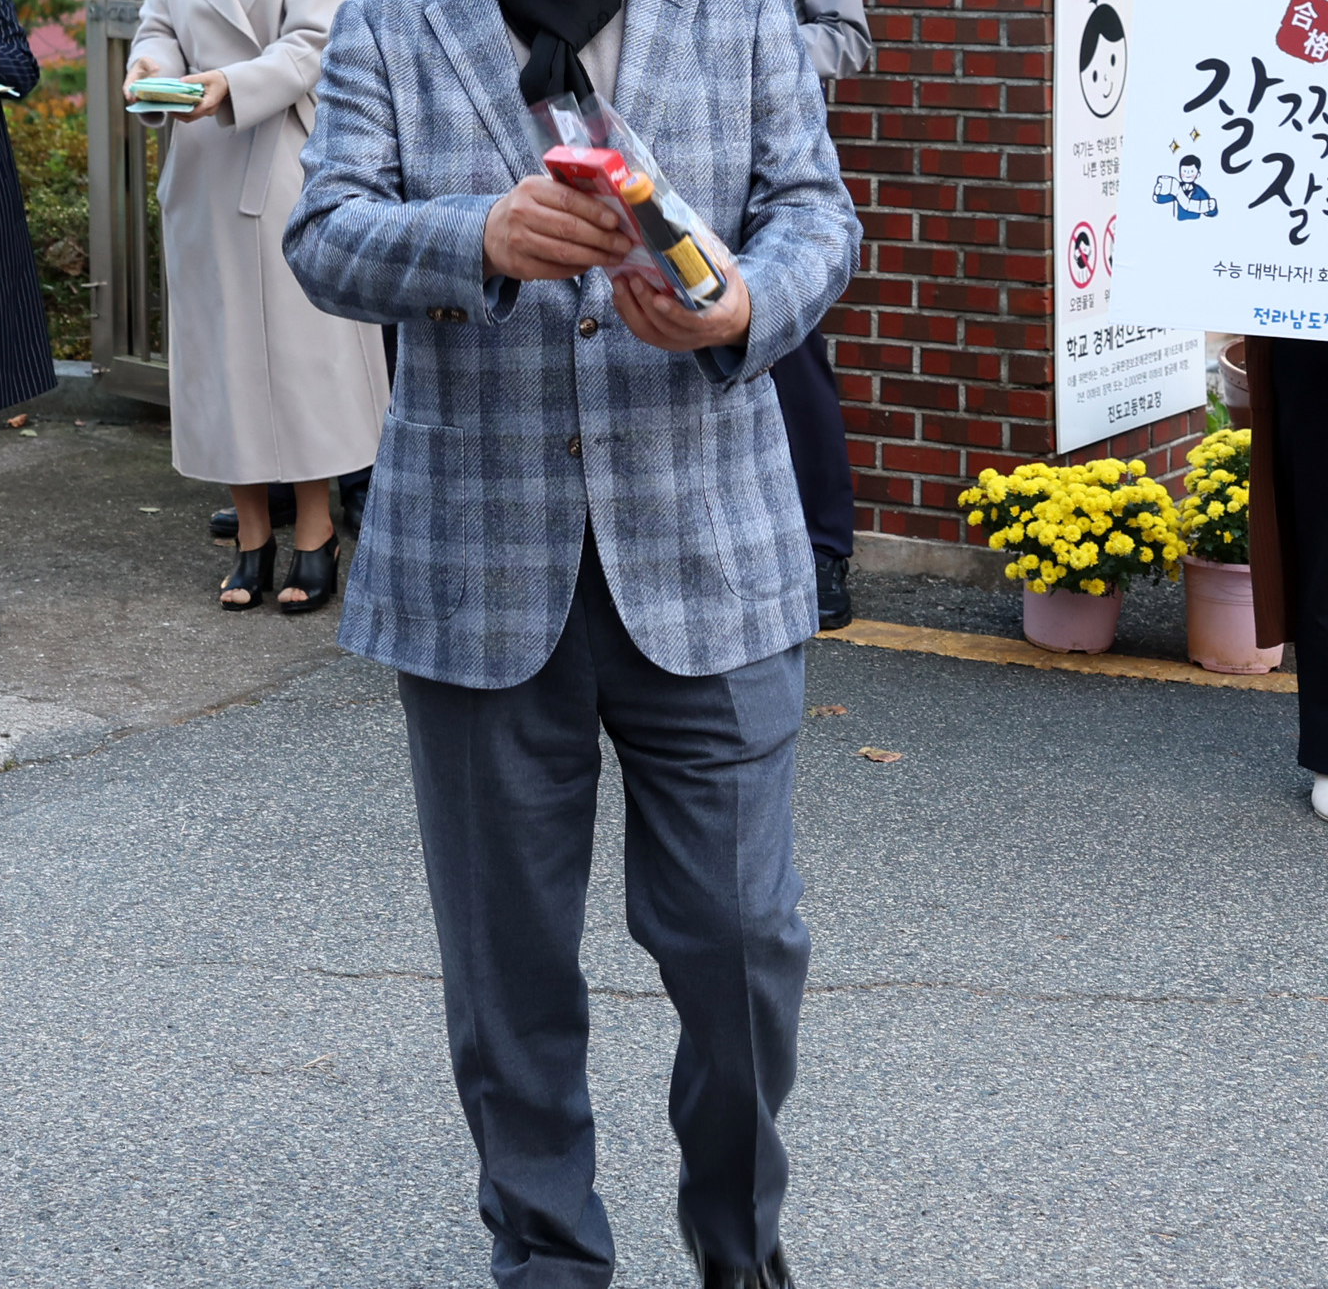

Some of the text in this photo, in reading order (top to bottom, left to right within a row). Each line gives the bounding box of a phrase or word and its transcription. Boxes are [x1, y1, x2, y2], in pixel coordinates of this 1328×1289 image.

[1073, 141, 1094, 158] 여기는
[1212, 260, 1243, 280] 수능
[1247, 262, 1314, 284] 대박나자!
[1069, 293, 1094, 312] 오염물질
[1067, 335, 1088, 362] 학교
[1107, 390, 1162, 424] 진도고등학교장
